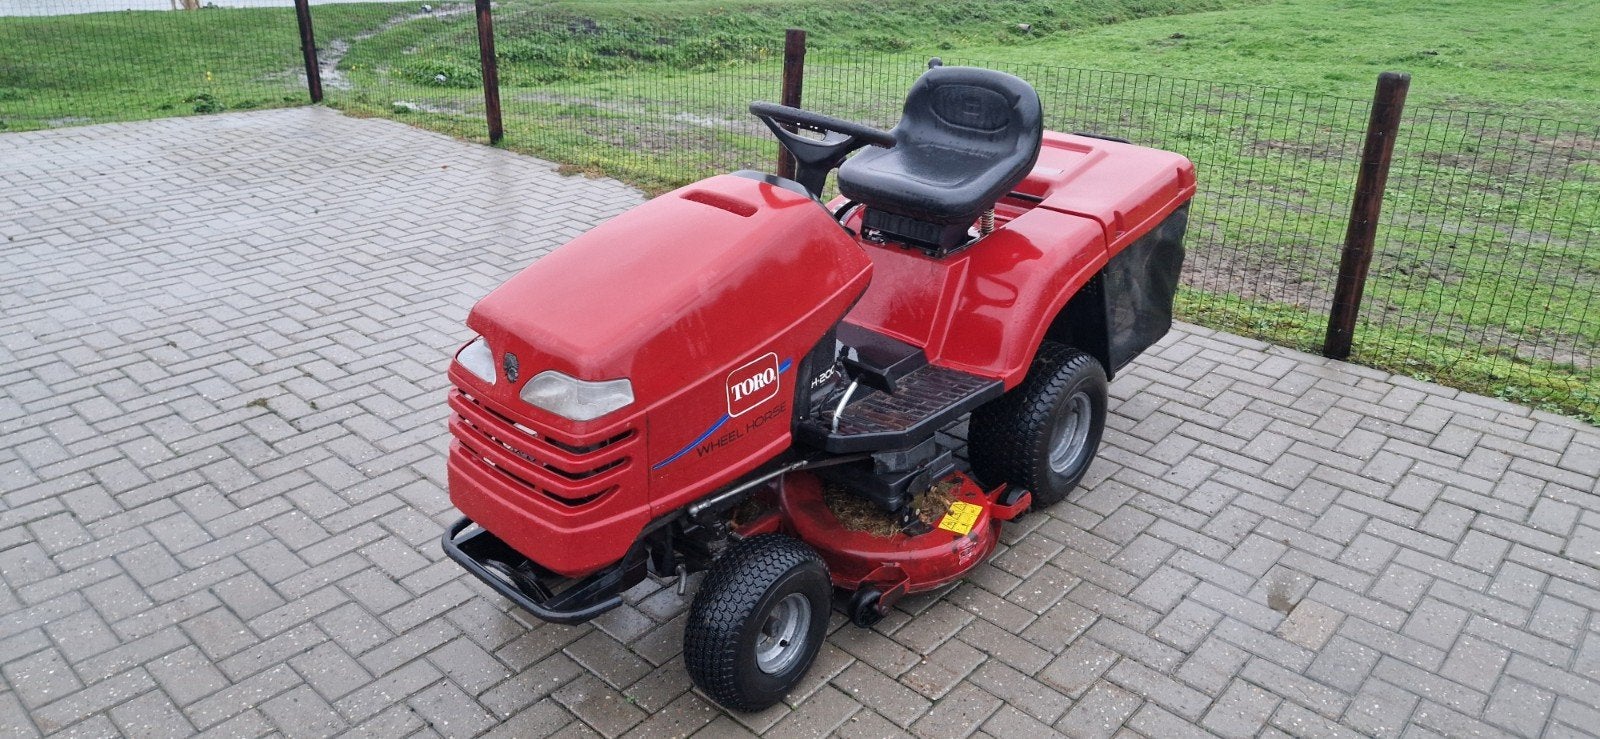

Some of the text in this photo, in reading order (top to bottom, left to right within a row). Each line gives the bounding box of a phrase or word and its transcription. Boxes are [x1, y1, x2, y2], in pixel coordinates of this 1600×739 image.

[731, 367, 776, 402] TORO
[697, 401, 787, 458] WHEEL HORSE
